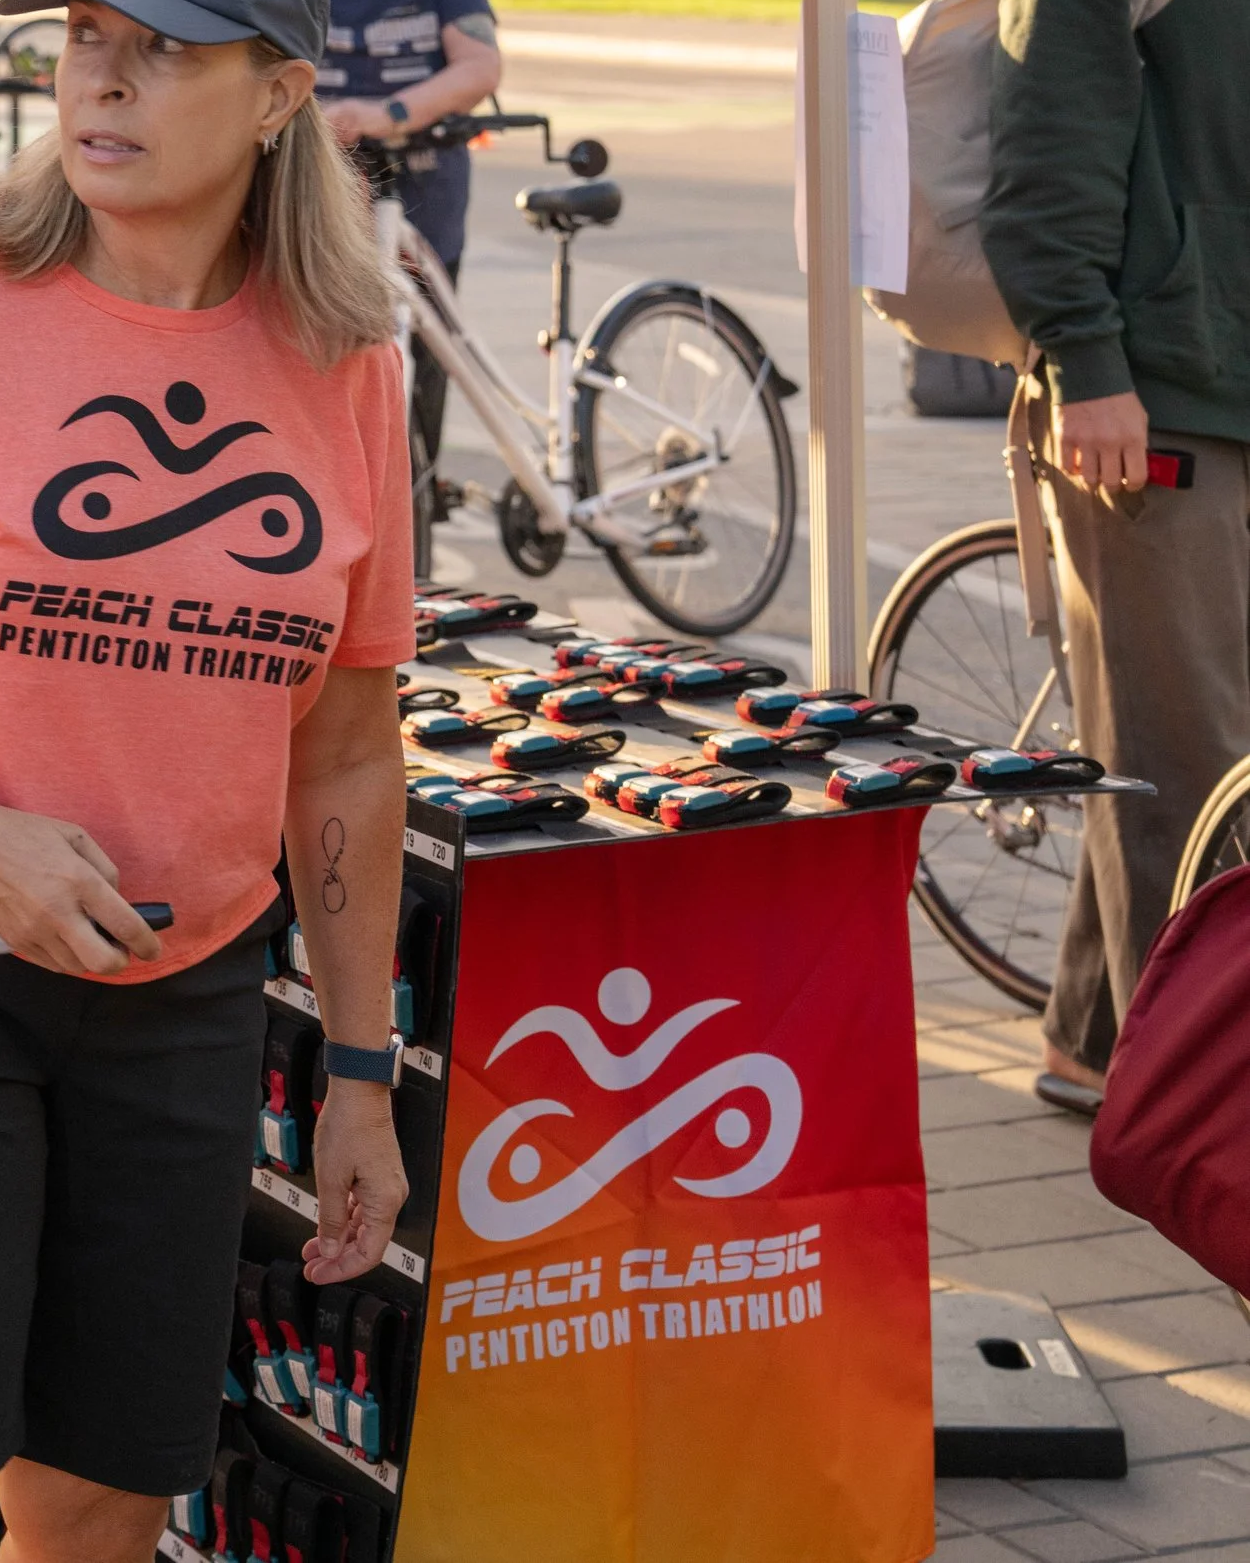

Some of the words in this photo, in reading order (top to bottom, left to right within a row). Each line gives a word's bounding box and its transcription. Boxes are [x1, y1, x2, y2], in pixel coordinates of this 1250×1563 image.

[167, 599, 336, 654] CLASSIC
[431, 841, 447, 862] 720
[274, 980, 288, 997] 735
[302, 992, 316, 1011] 736
[418, 1050, 433, 1070] 740
[259, 1171, 273, 1191] 755
[287, 1188, 300, 1207] 756
[401, 1253, 416, 1274] 760
[439, 1256, 603, 1324] PEACH
[619, 1224, 822, 1293] CLASSIC
[445, 1306, 632, 1373] PENTICTON
[637, 1280, 823, 1340] TRIATHLON
